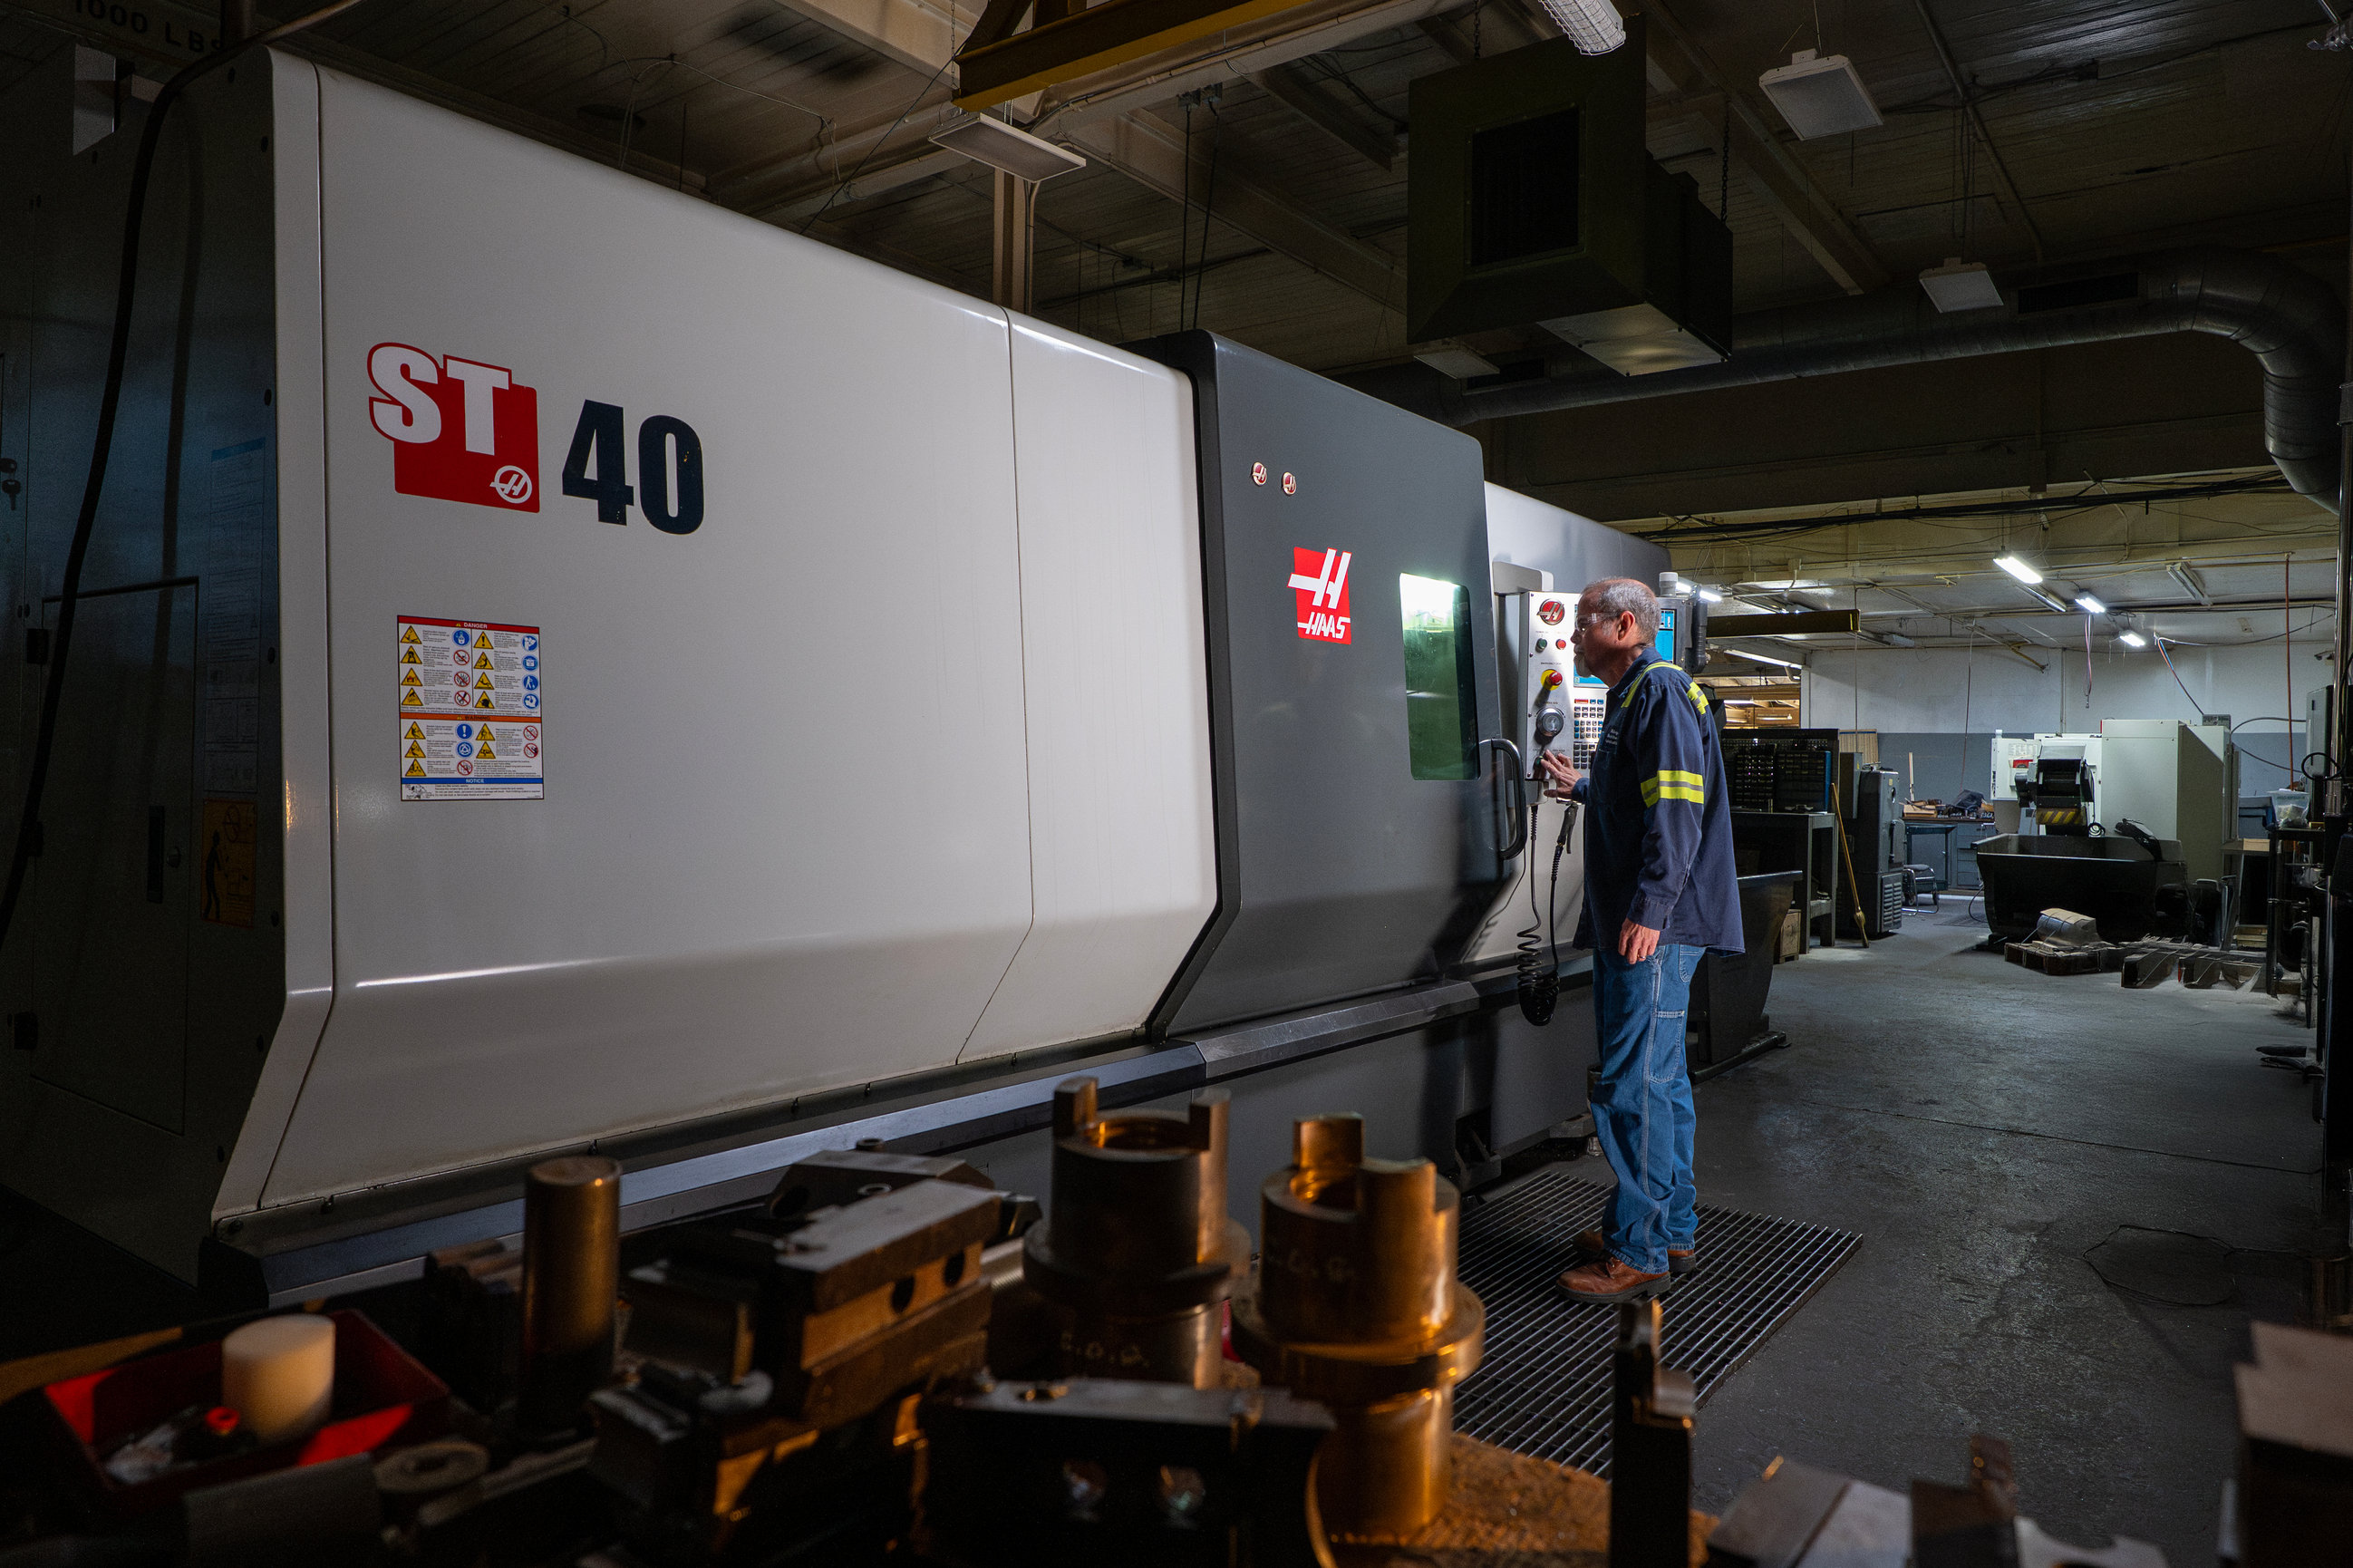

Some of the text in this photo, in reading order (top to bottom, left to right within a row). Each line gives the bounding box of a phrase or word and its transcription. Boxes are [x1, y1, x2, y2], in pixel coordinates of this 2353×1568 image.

[368, 343, 703, 535] ST 40
[463, 622, 488, 630] DANGER
[1297, 611, 1351, 640] HAAS
